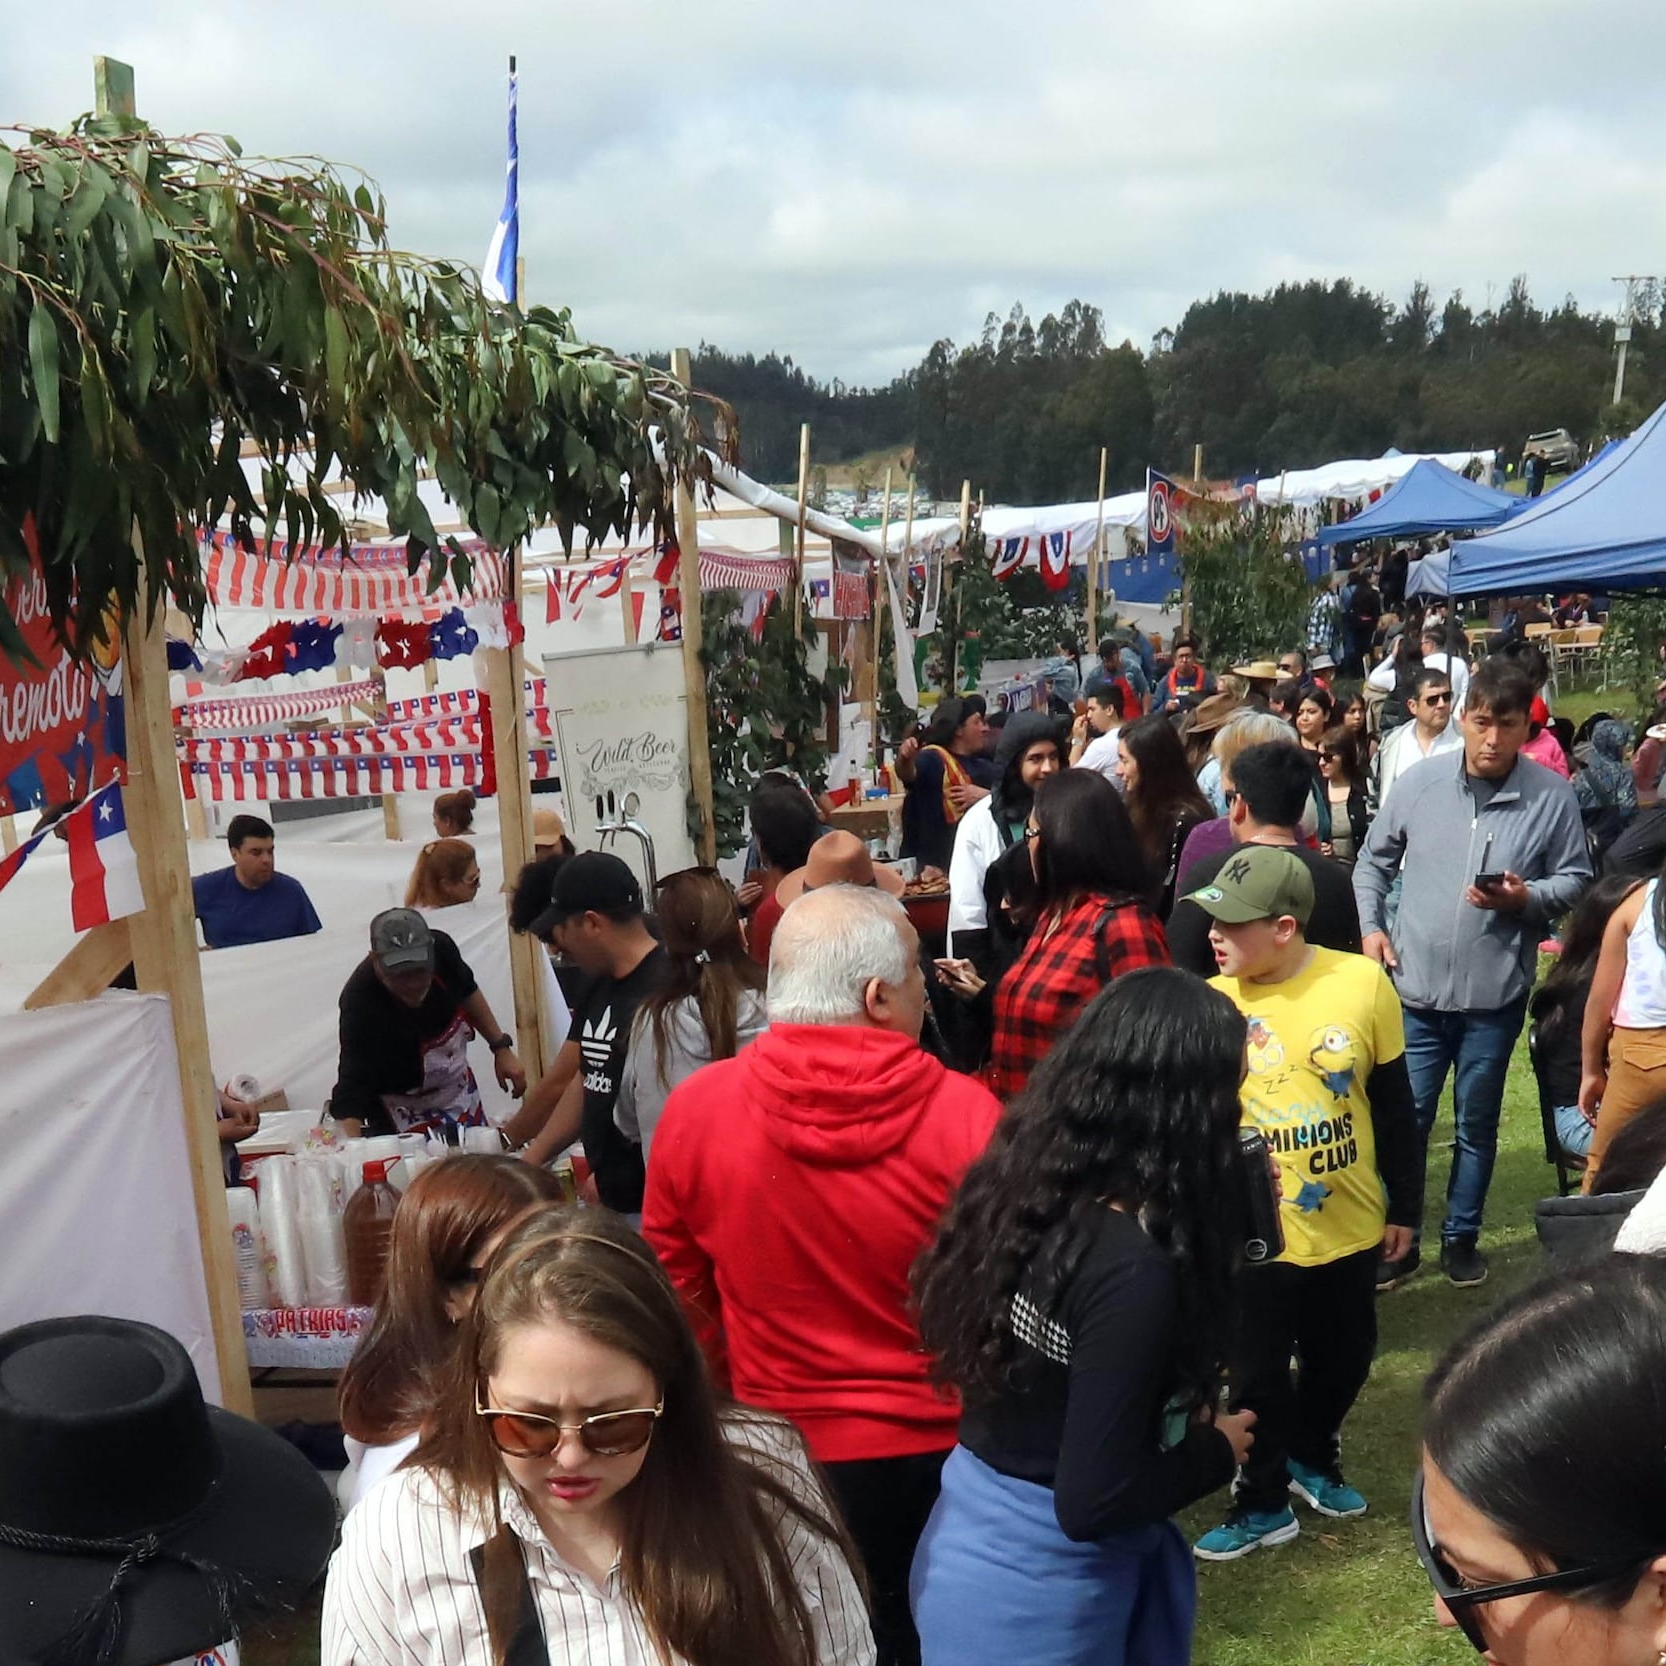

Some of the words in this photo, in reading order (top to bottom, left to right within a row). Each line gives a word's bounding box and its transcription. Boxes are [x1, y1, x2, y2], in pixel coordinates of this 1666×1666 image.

[576, 737, 634, 773] Wild
[636, 732, 676, 762] Beer
[1264, 1112, 1353, 1152] MINIONS
[1309, 1138, 1358, 1175] CLUB
[275, 1308, 347, 1333] PATRIAS
